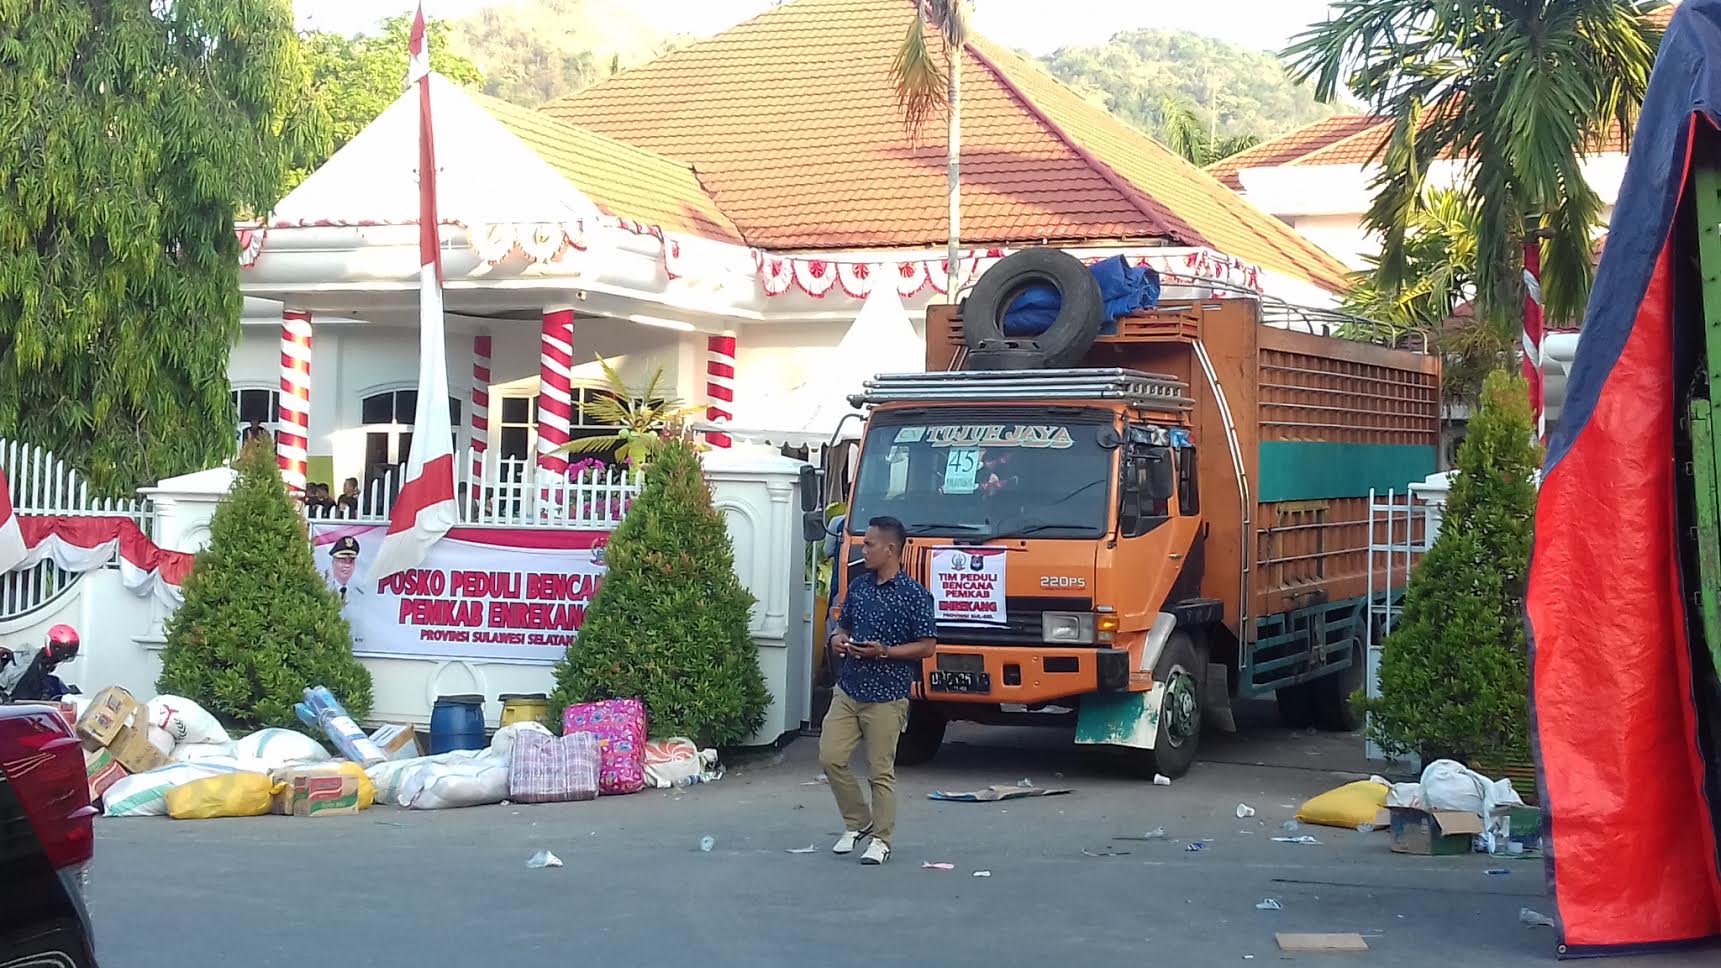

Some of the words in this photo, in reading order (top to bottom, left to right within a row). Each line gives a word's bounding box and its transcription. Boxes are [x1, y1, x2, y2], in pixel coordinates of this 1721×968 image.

[1006, 426, 1075, 448] JAYA
[949, 450, 975, 473] 45
[377, 568, 446, 597] POSKO
[450, 570, 521, 599] PEDULI
[938, 573, 957, 581] TIM
[960, 573, 997, 582] PEDULI
[1040, 576, 1086, 588] 220PS
[942, 581, 994, 590] BENCANA
[945, 590, 990, 598] PEMKAB
[939, 600, 997, 612] ENREKANG
[399, 597, 484, 628] PEMKAB
[488, 601, 589, 632] ENREKAN
[420, 629, 470, 643] PROVINSI
[472, 631, 525, 645] SULAWESI
[527, 633, 577, 646] SELATAN
